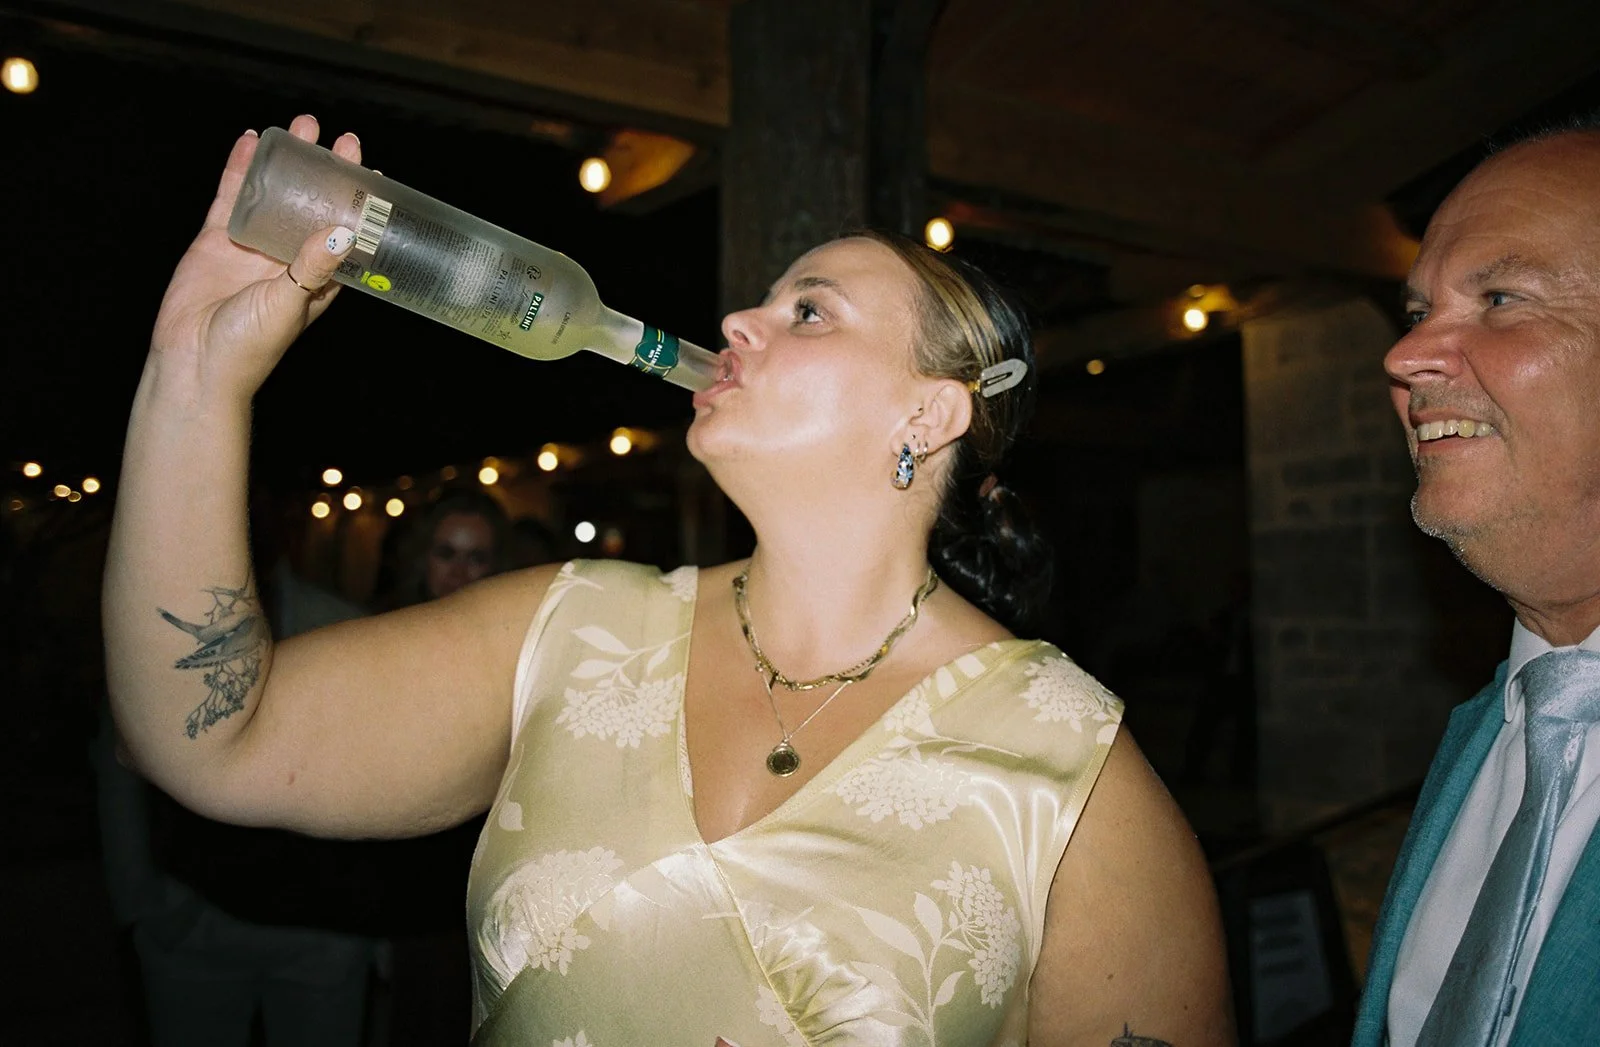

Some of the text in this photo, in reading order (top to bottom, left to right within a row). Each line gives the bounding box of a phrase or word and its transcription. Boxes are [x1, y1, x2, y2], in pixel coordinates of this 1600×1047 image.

[355, 189, 365, 200] 50
[481, 269, 508, 319] PALLINI SPA
[521, 295, 542, 331] PALLINI
